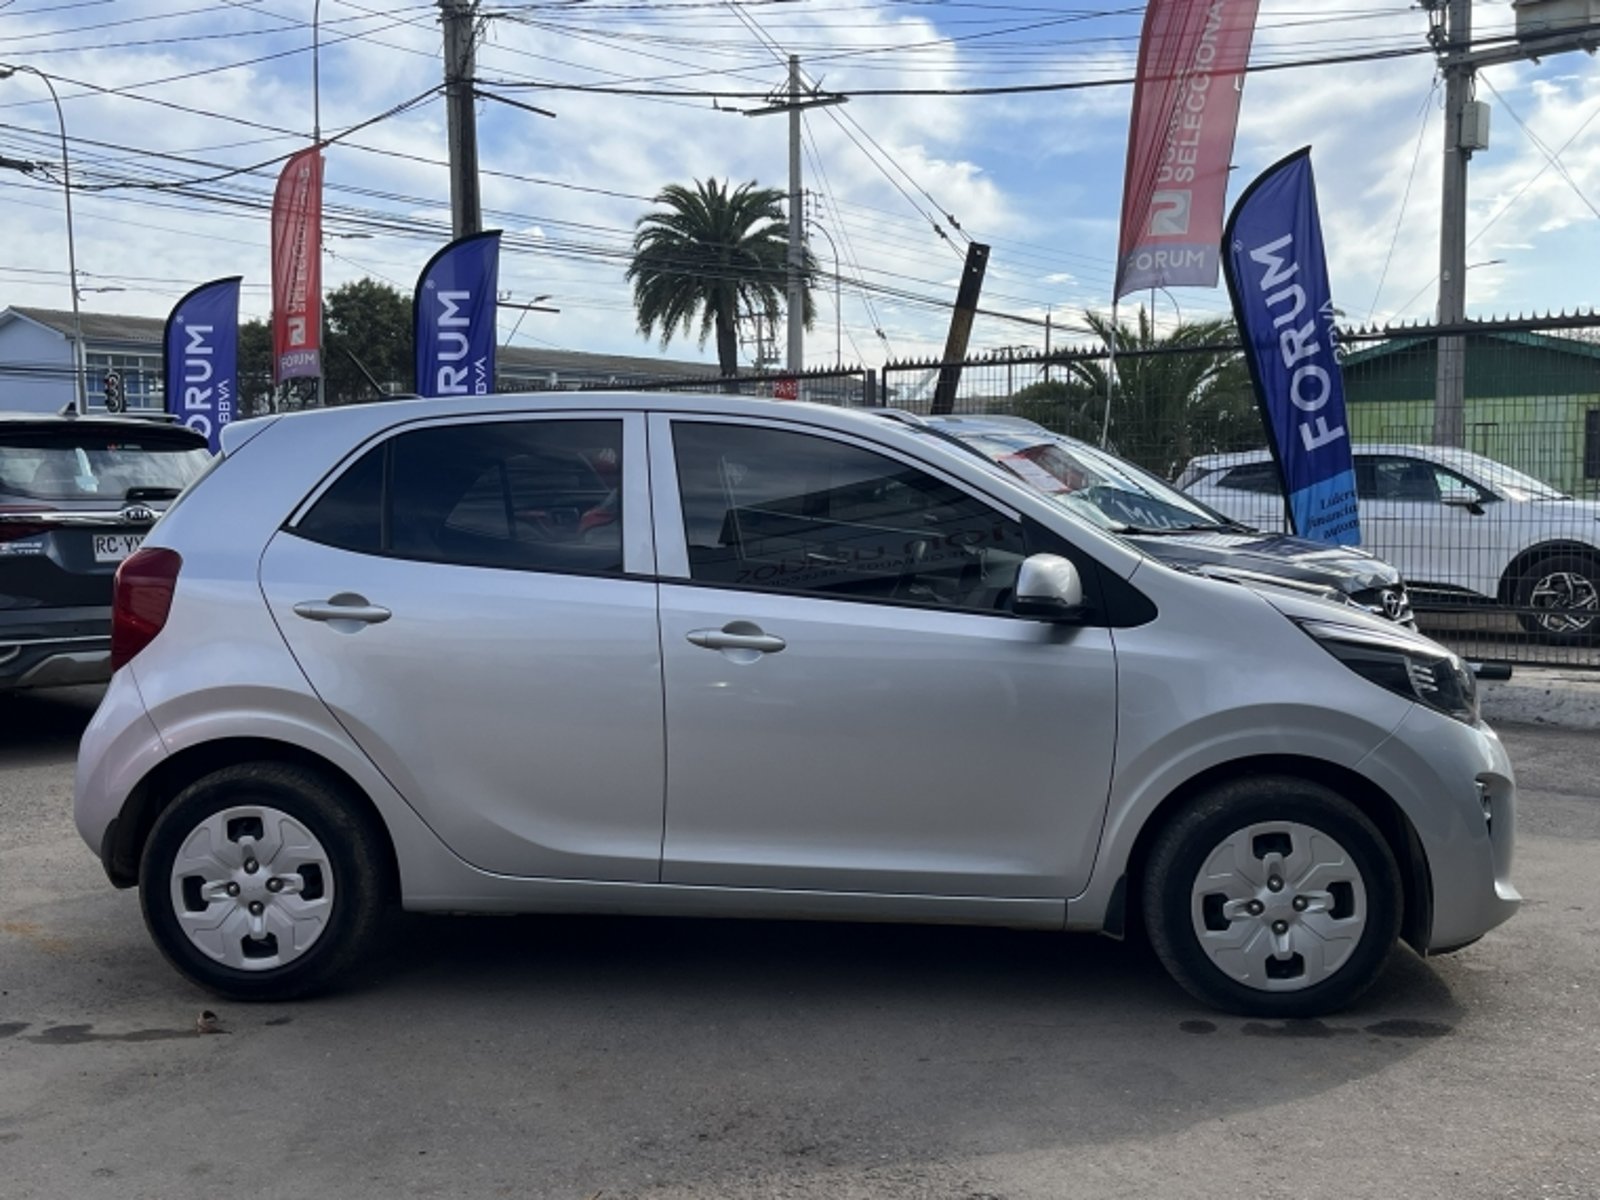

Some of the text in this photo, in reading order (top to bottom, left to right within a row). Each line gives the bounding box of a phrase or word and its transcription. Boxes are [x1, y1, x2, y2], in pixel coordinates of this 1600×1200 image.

[1175, 2, 1225, 182] SELECCIONA
[184, 325, 214, 439] ORUM
[281, 353, 316, 370] FORUM
[437, 291, 470, 394] RUM
[474, 356, 487, 396] BVA
[1250, 233, 1345, 451] FORUM
[218, 379, 231, 424] BBVA
